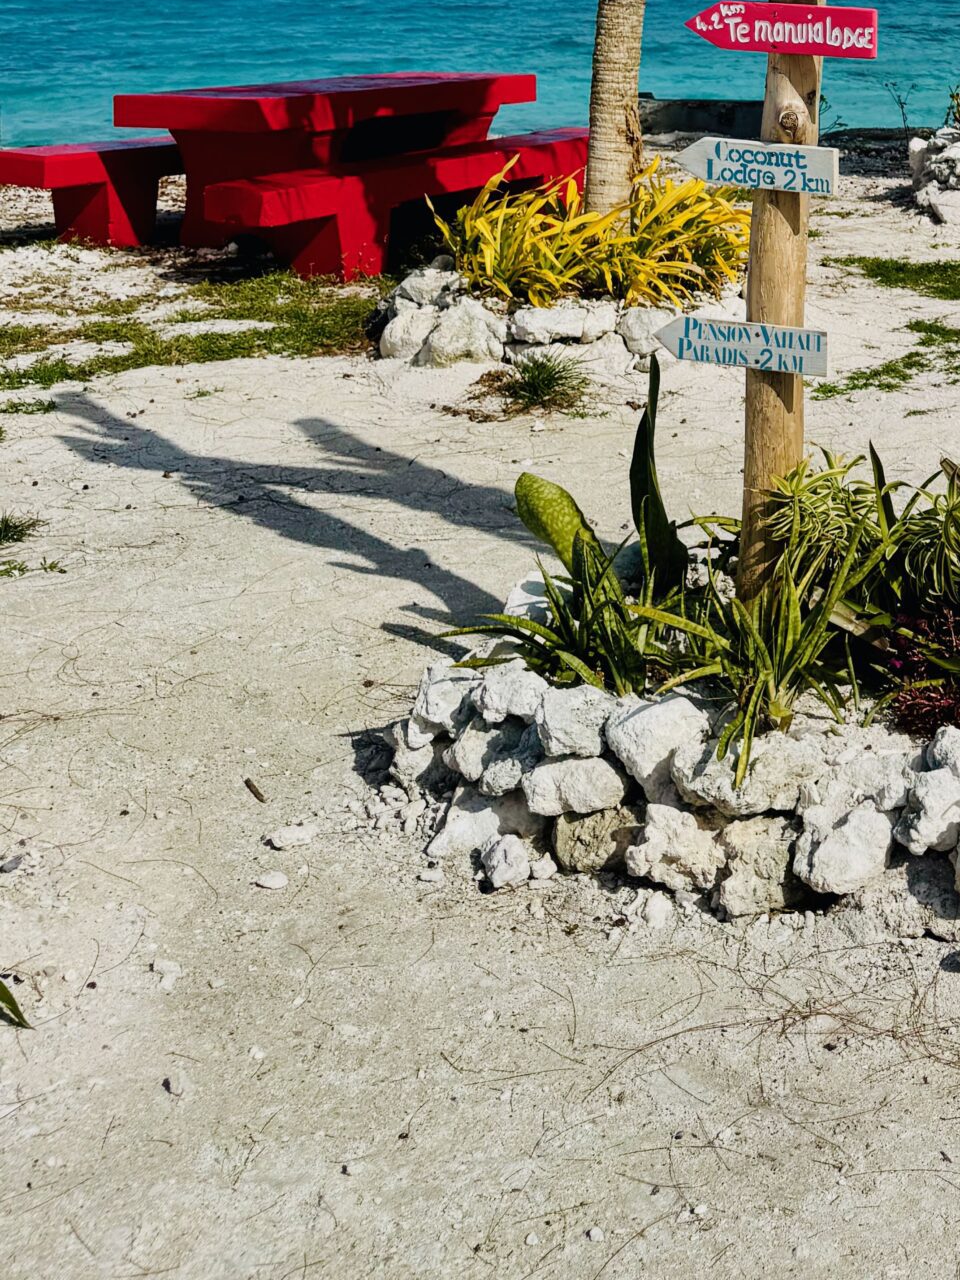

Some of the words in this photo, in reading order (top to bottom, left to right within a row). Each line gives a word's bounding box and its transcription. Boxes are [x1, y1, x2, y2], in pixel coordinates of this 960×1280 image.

[724, 17, 750, 43] Te
[715, 141, 808, 169] Coconut
[707, 159, 775, 188] Lodge
[783, 170, 796, 190] 2
[684, 317, 752, 343] PENSION
[678, 337, 749, 366] PARADIS
[760, 349, 773, 370] 2
